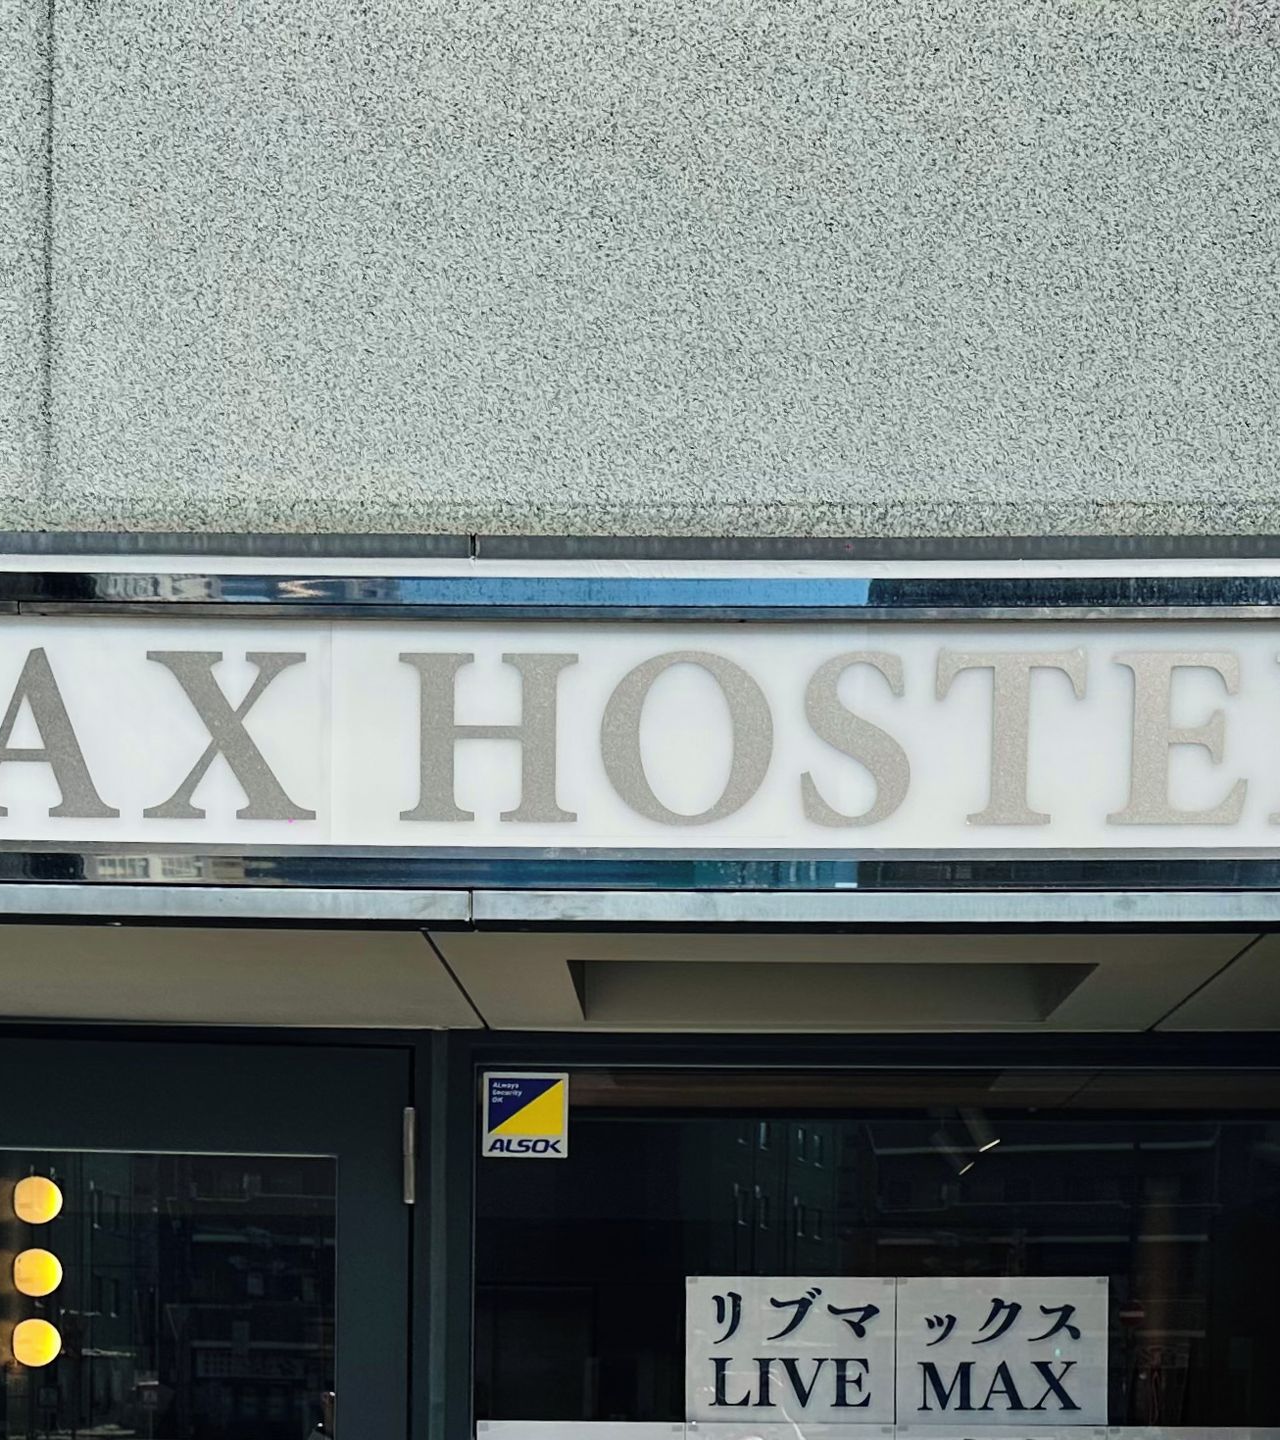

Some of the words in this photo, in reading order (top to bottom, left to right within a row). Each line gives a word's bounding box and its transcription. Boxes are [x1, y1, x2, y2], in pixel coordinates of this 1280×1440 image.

[488, 1138, 562, 1153] ALSOK
[711, 1287, 881, 1345] リブマ
[923, 1296, 1083, 1347] ックス
[707, 1357, 873, 1409] LIVE
[916, 1360, 1082, 1411] MAX
